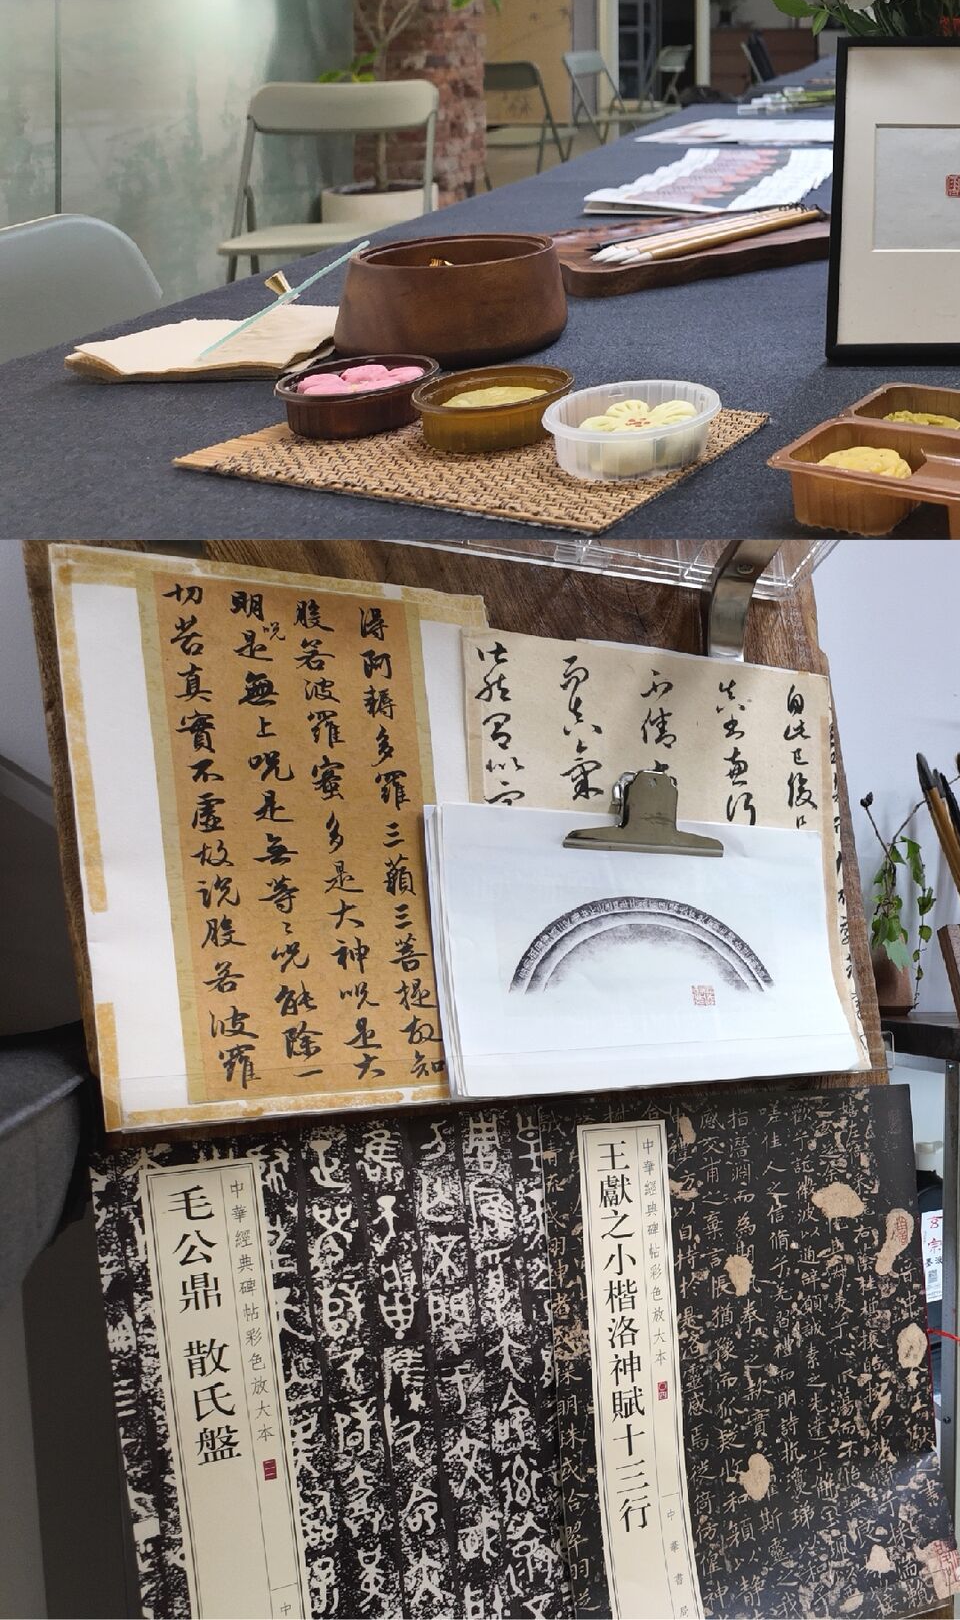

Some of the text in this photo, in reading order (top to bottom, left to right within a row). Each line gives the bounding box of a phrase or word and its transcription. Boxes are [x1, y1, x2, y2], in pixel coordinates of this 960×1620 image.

[166, 1184, 242, 1466] 毛公鼎 散氏盤
[229, 1178, 276, 1444] 中華經典碑帖彩色放大本
[596, 1139, 652, 1533] 王獻之小楷洛神賦十三行
[641, 1137, 667, 1367] 中華經典碑帖彩色放大本
